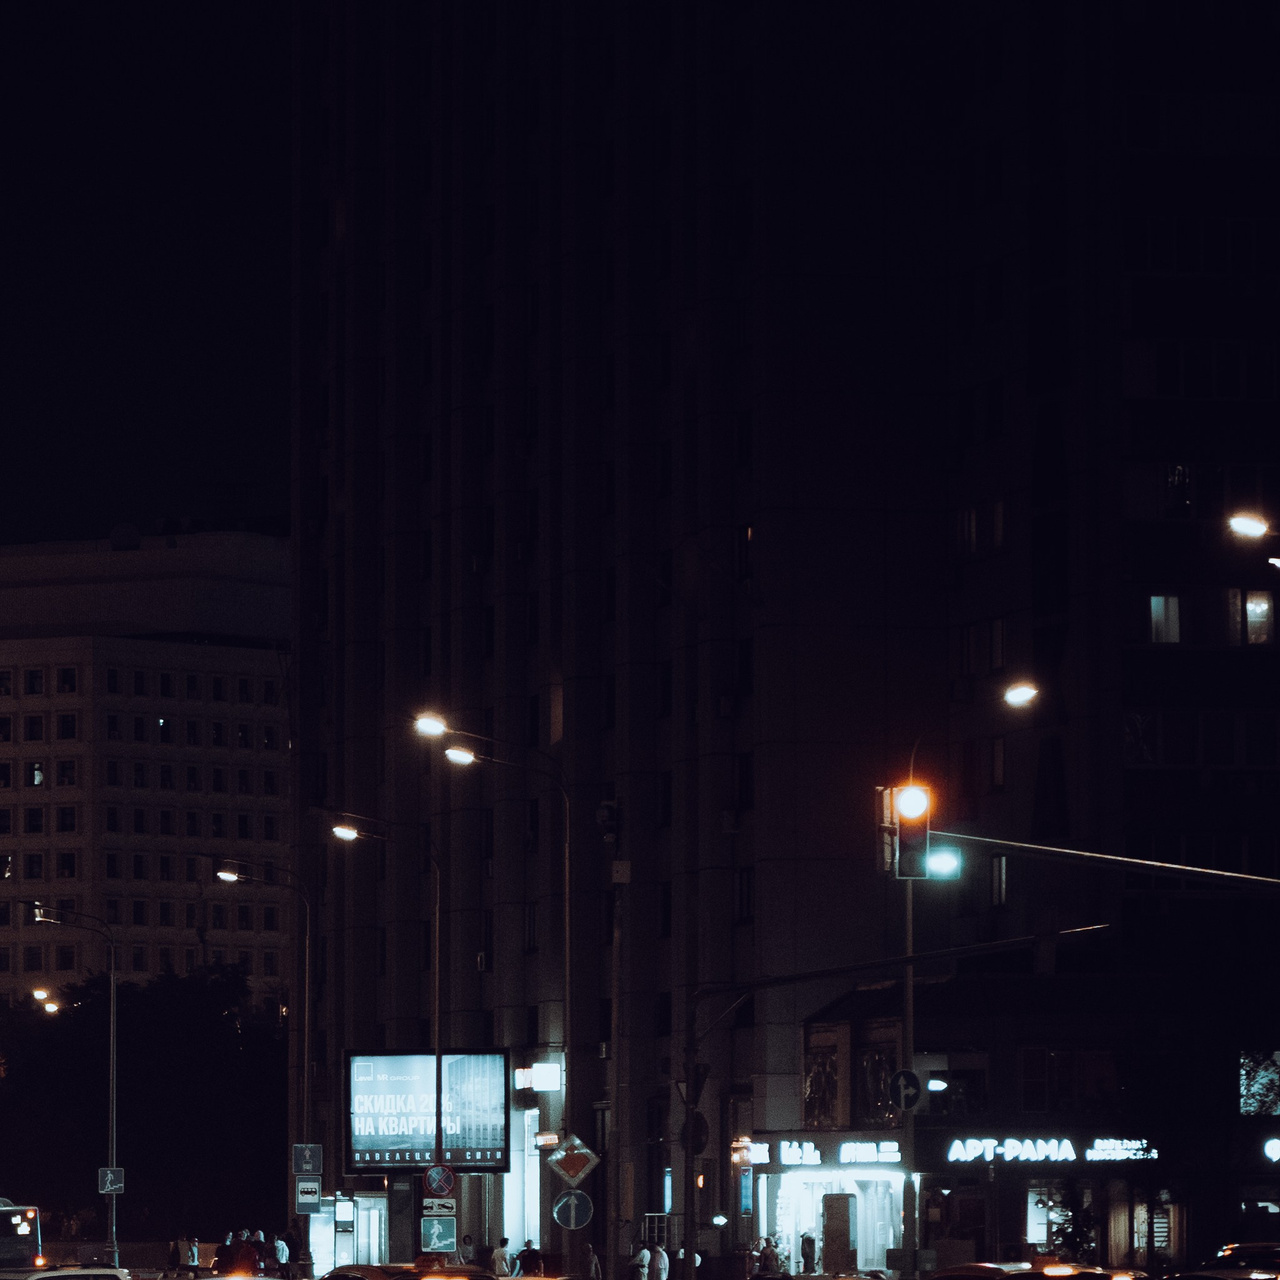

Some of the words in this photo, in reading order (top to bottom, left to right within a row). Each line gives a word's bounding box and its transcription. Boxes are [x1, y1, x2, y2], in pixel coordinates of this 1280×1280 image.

[354, 1094, 417, 1115] СКИДКА
[354, 1116, 376, 1136] НА
[354, 1151, 452, 1161] ПАВЕЛЕЦКЯ
[947, 1138, 1077, 1162] АРТ-РАМА
